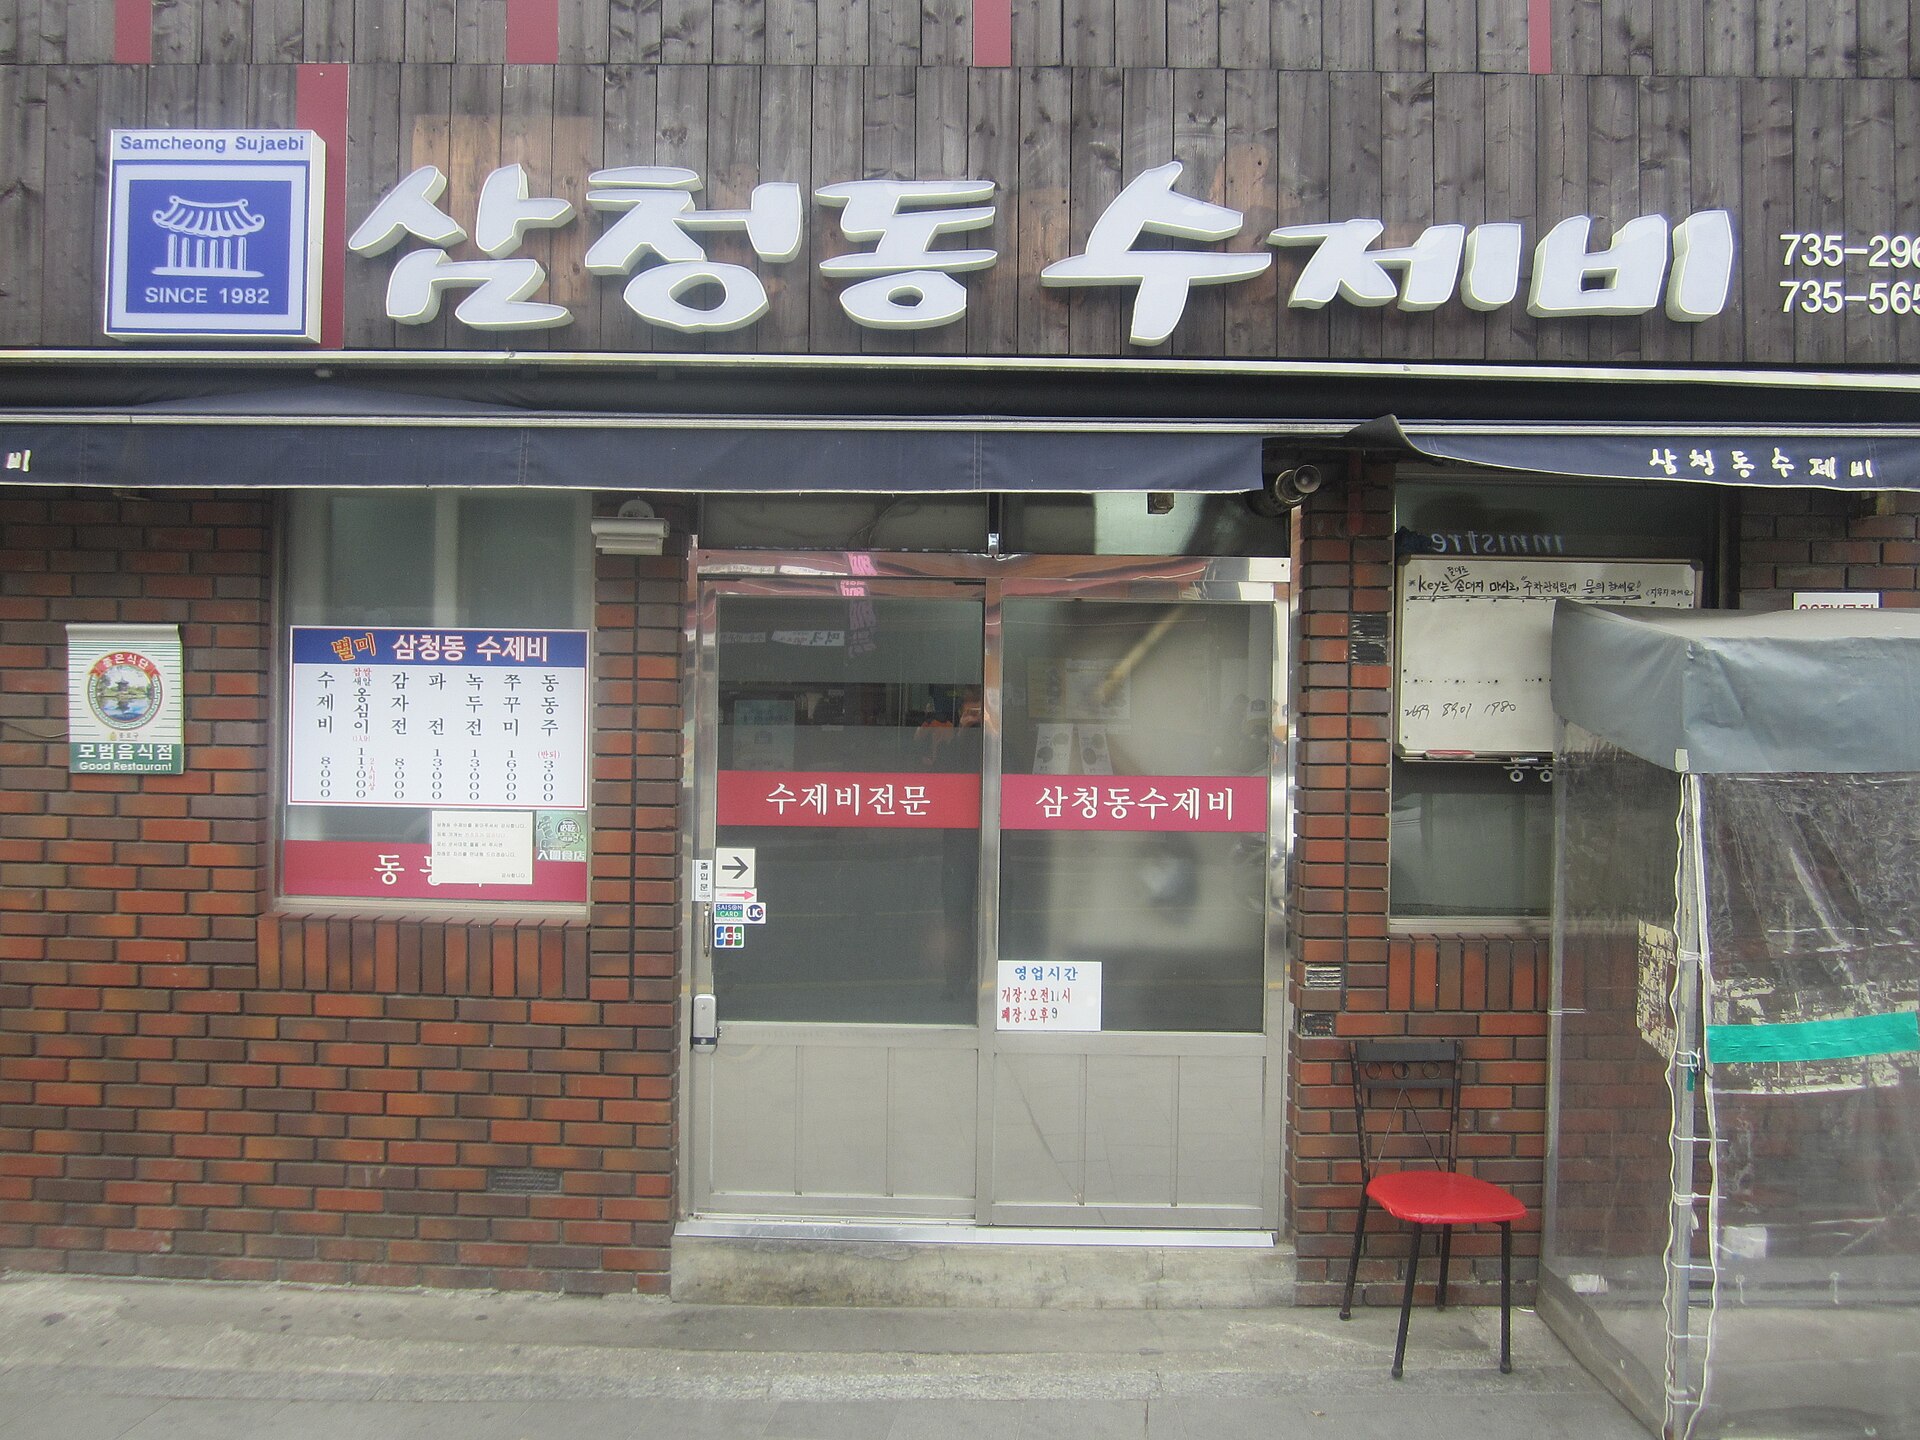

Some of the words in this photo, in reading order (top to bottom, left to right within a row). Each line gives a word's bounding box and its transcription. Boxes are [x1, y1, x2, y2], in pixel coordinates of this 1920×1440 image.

[120, 135, 226, 154] Samcheong
[235, 136, 304, 154] Sujaebi
[348, 164, 998, 334] 삼청동
[1041, 160, 1734, 346] 수제비
[145, 287, 208, 304] SINCE
[219, 287, 270, 304] 1982
[331, 632, 377, 662] 별미
[392, 635, 466, 661] 삼청동
[476, 635, 549, 662] 수제비
[316, 671, 335, 734] 수제비
[353, 687, 371, 734] 옹심이
[391, 672, 409, 735] 감자전
[465, 673, 484, 737] 녹두전
[503, 674, 522, 737] 쭈꾸미
[541, 674, 560, 737] 동동주
[78, 744, 172, 760] 모범음식점
[79, 762, 111, 770] Good
[113, 762, 172, 771] Restaurant
[765, 783, 931, 816] 수제비전문
[1035, 787, 1234, 821] 삼청동수제비
[1014, 966, 1078, 981] 영업시간
